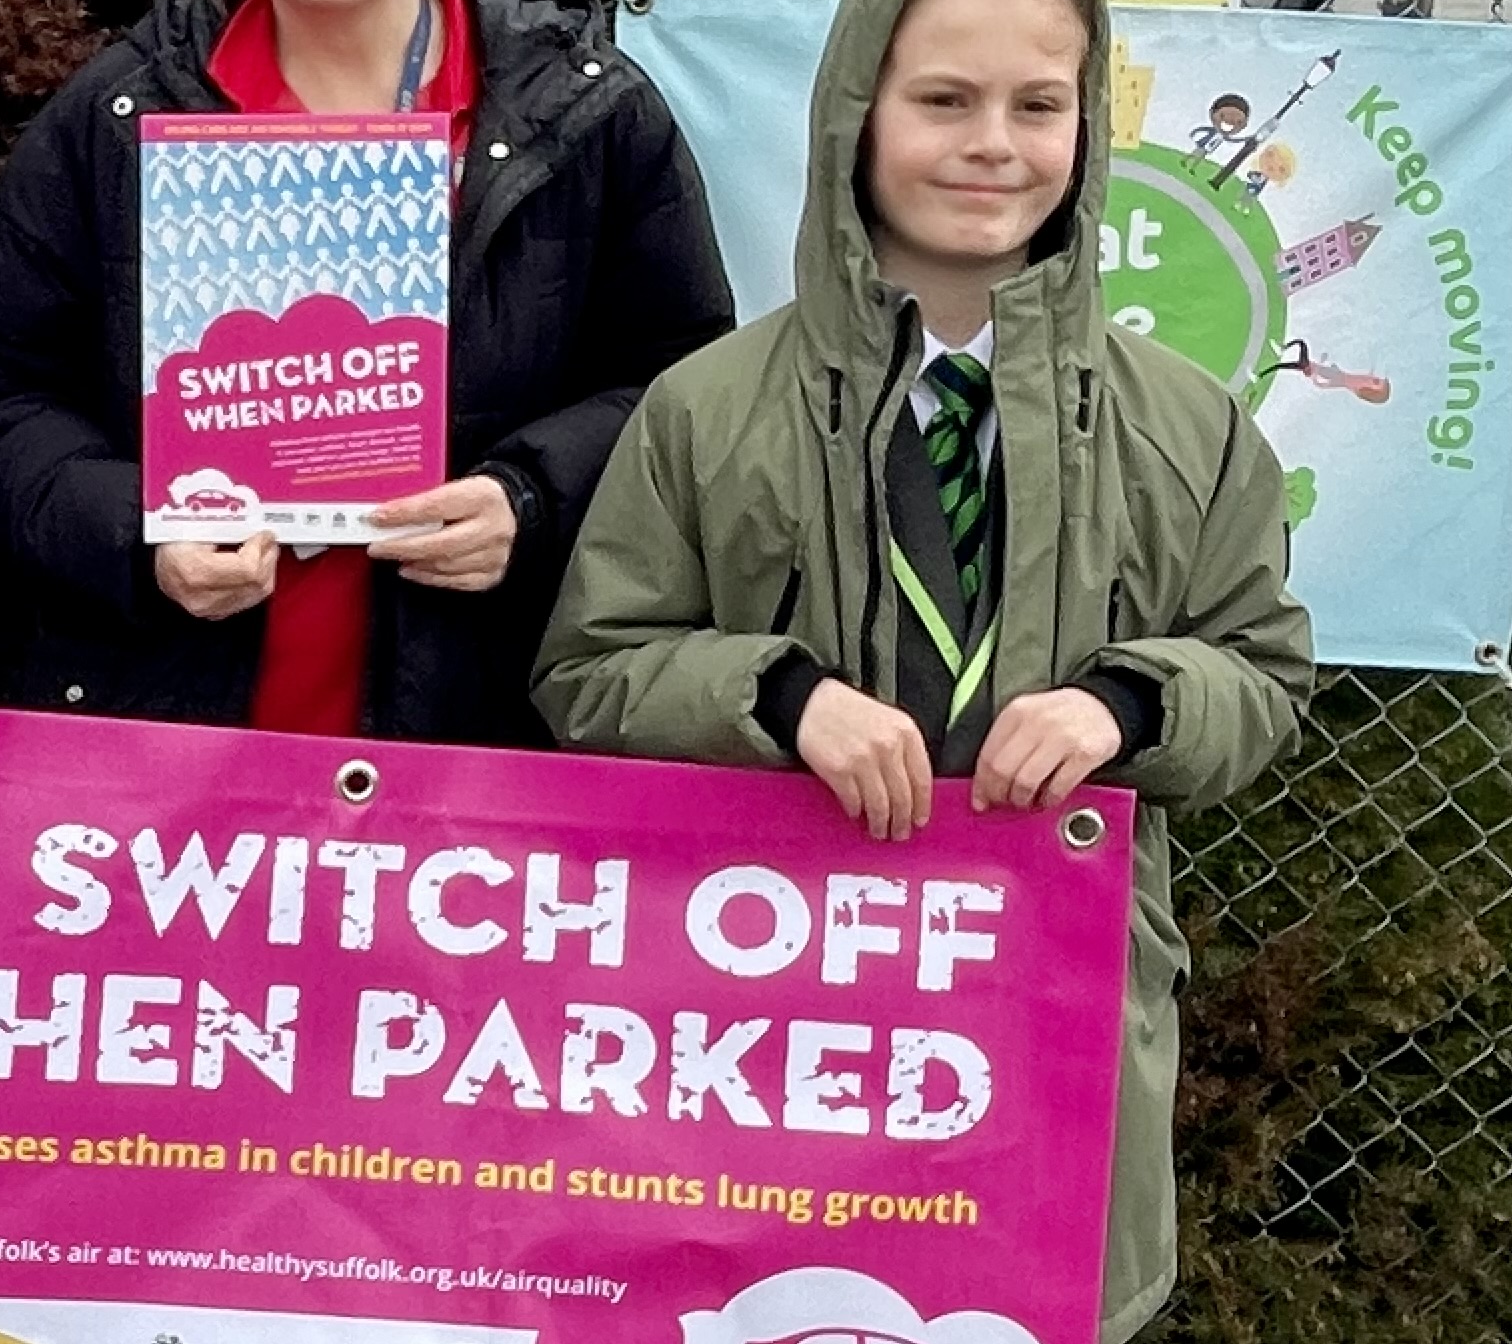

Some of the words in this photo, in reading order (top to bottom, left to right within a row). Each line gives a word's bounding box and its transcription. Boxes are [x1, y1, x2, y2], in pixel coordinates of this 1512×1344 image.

[1345, 83, 1443, 218] Keep
[1426, 226, 1495, 471] moving!
[178, 352, 333, 399] SWITCH
[342, 342, 419, 380] OFF
[185, 400, 285, 432] WHEN
[291, 381, 424, 422] PARKED
[30, 822, 631, 967] SWITCH
[684, 864, 1006, 993] OFF
[350, 988, 995, 1141] PARKED
[70, 1135, 226, 1171] asthma
[238, 1139, 276, 1174] in
[290, 1143, 461, 1186] children
[475, 1158, 556, 1193] and
[567, 1167, 705, 1206] stunts
[717, 1174, 814, 1223] lung
[822, 1190, 979, 1228] growth
[67, 1242, 100, 1264] air
[106, 1244, 141, 1265] at:
[146, 1248, 627, 1304] www.healthysuffolk.org.uk/airquality
